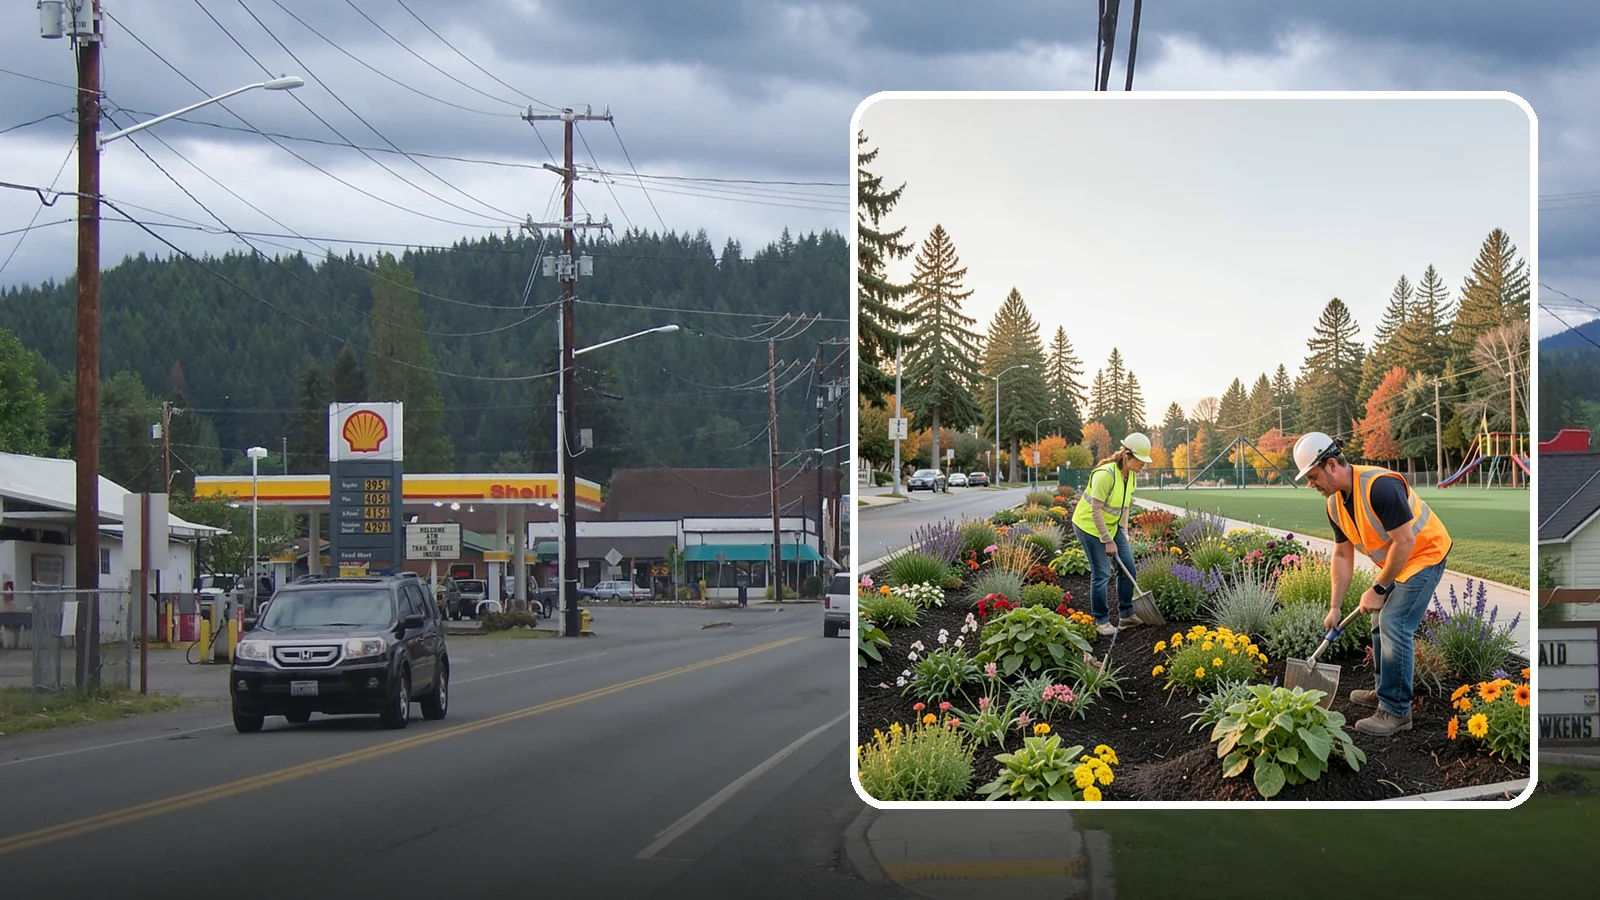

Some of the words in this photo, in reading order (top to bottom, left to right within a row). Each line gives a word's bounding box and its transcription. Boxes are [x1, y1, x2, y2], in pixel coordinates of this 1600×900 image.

[365, 480, 384, 490] 395
[490, 484, 547, 499] Shell
[365, 494, 384, 504] 405
[365, 508, 384, 518] 415
[365, 522, 384, 532] 429
